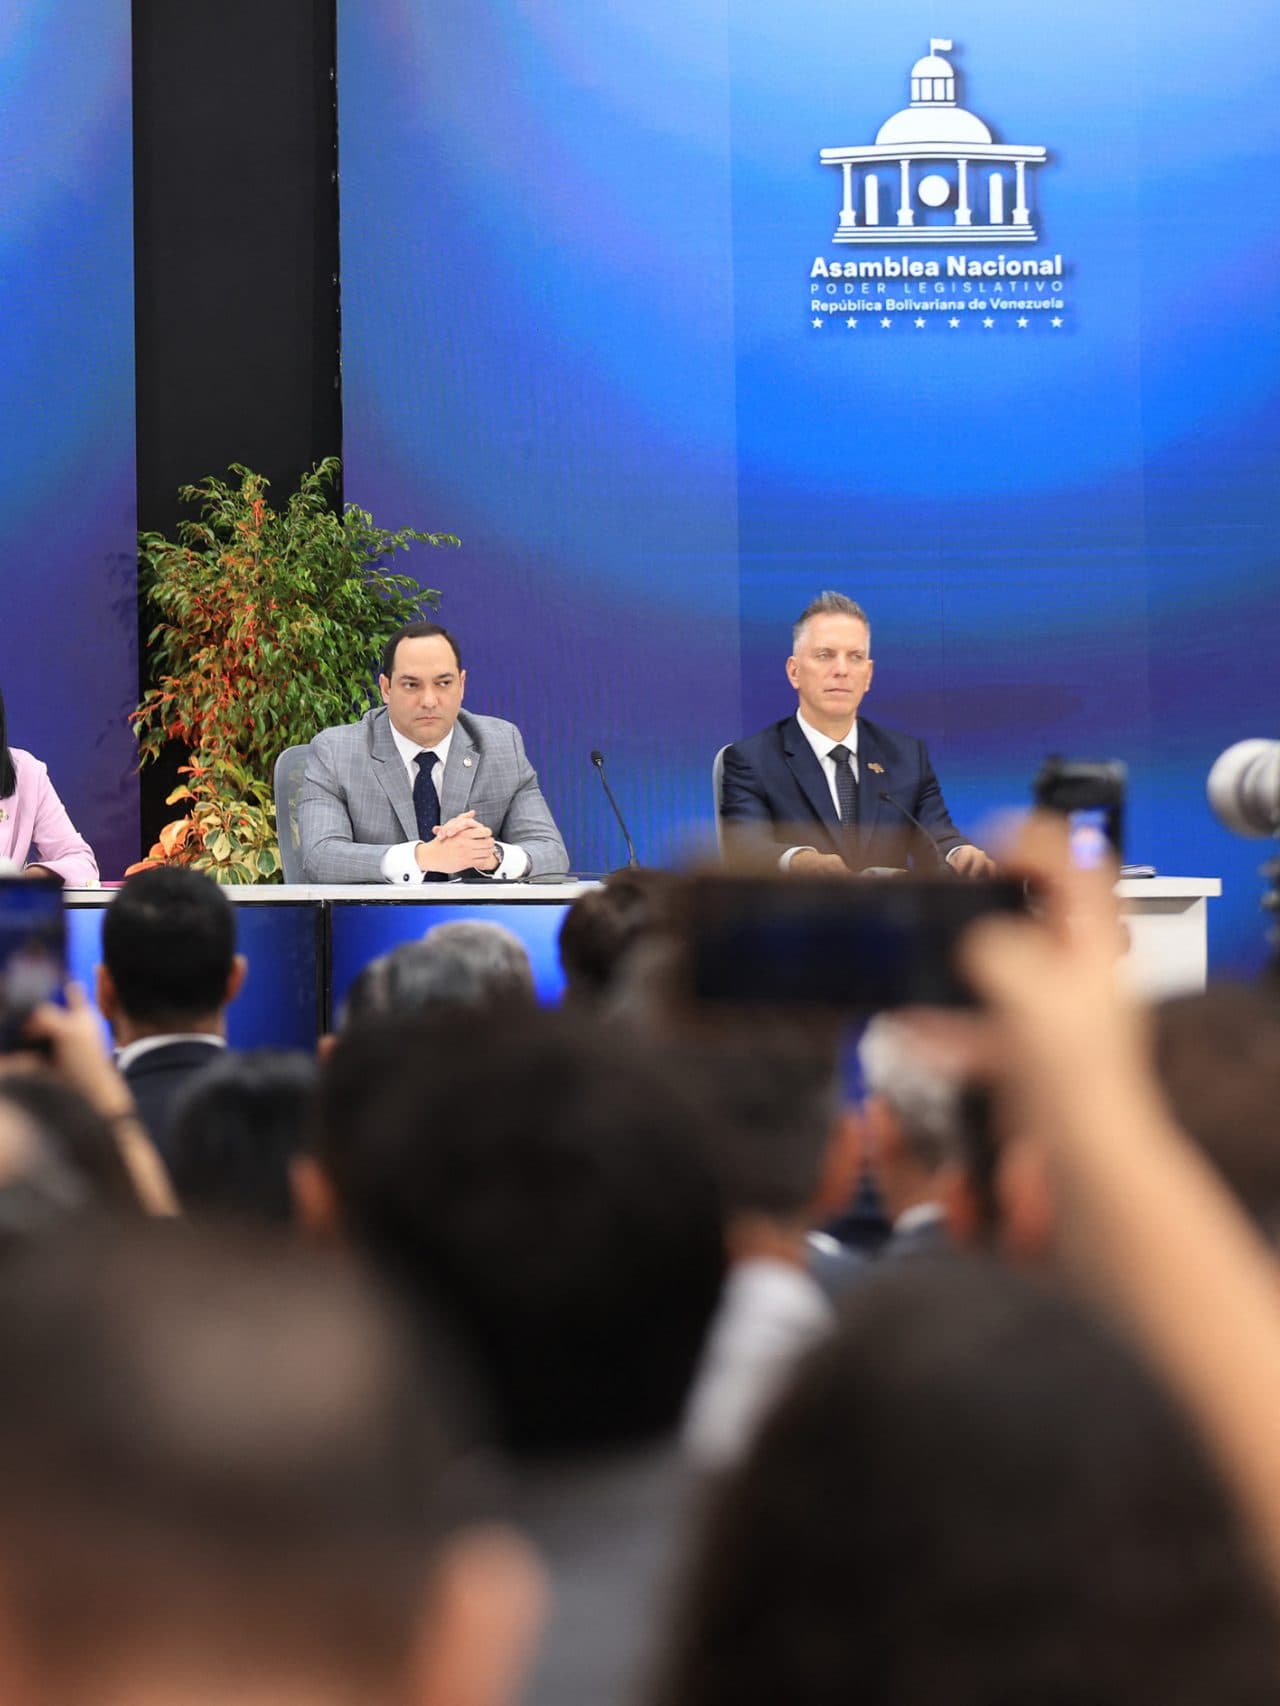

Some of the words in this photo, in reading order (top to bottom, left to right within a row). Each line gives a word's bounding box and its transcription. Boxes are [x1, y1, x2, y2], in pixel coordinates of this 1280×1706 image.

[810, 256, 940, 278] Asamblea
[947, 254, 1062, 276] Nacional
[811, 282, 886, 294] PODER
[904, 280, 1063, 293] LEGISLATIVO
[811, 299, 883, 313] República
[885, 298, 965, 311] Bolivariana
[968, 298, 987, 310] de
[989, 297, 1064, 310] Venezuela
